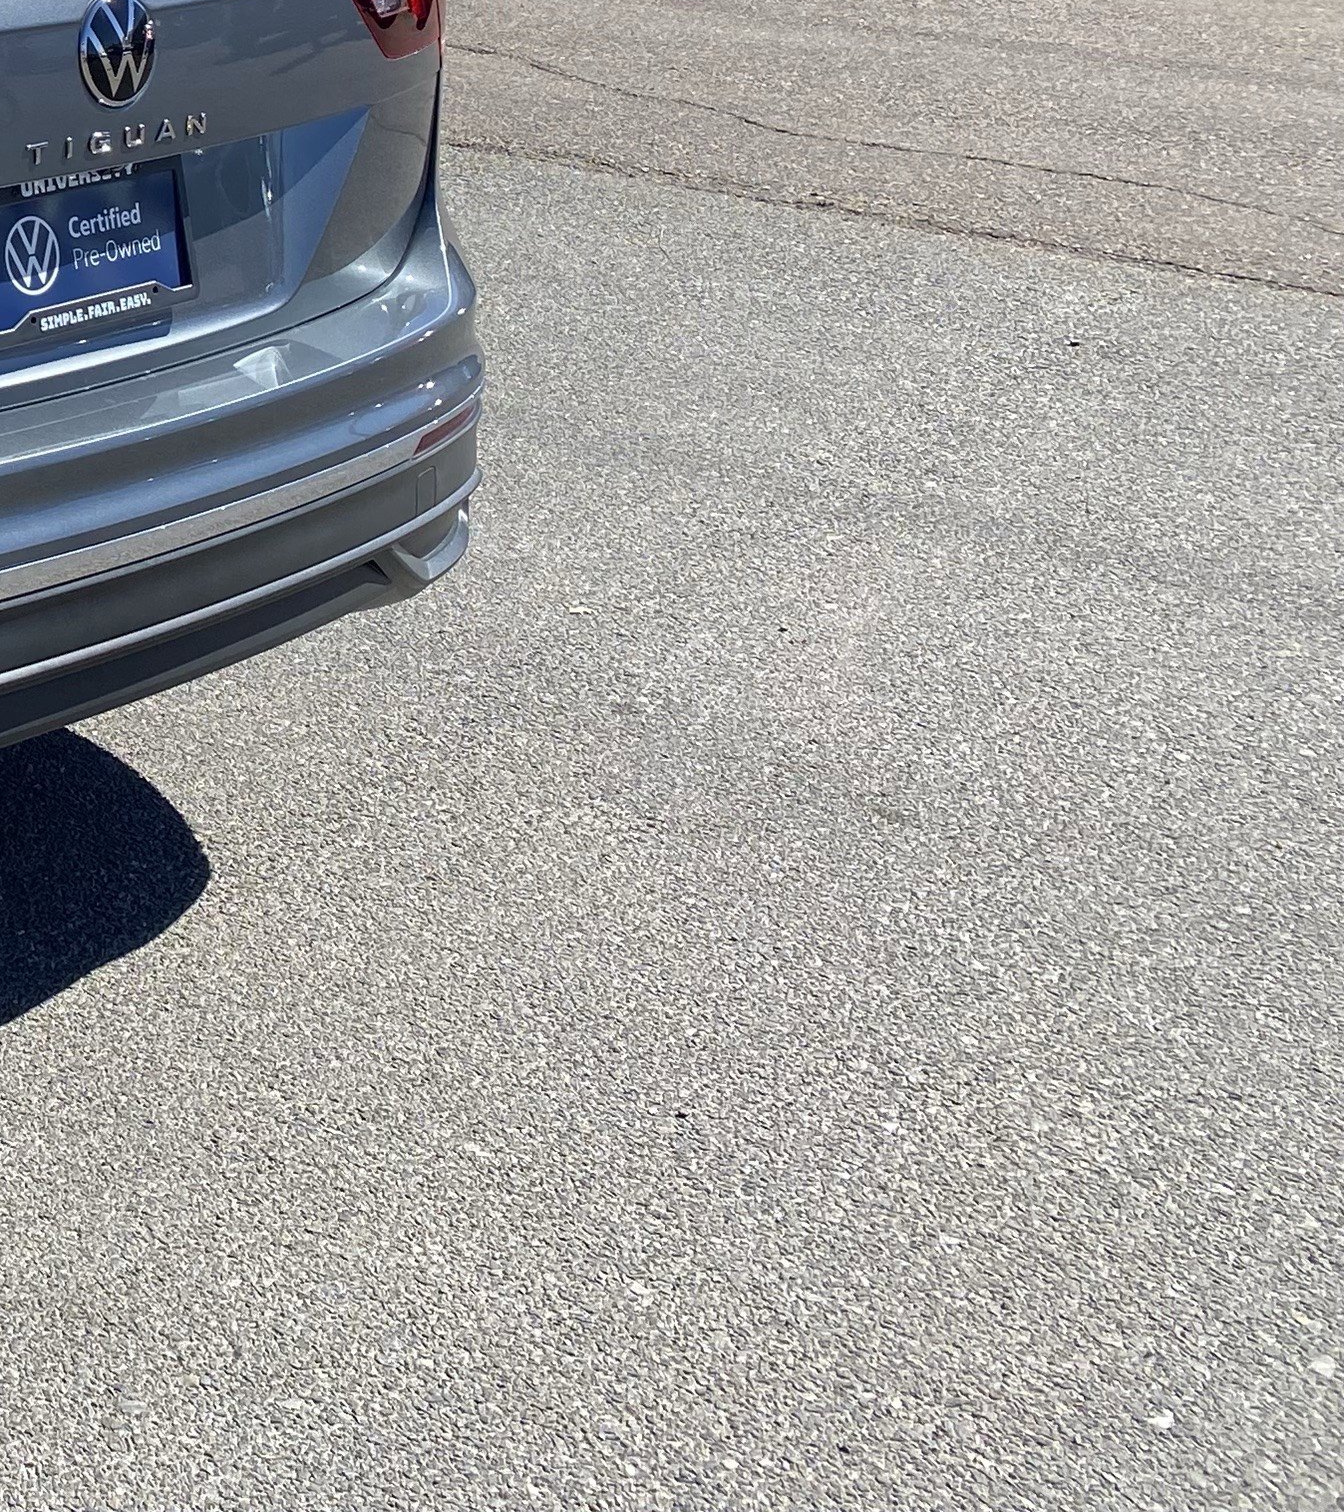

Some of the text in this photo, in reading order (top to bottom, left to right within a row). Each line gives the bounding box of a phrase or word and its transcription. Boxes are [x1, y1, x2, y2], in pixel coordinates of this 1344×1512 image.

[26, 112, 208, 166] TIGUAN
[68, 202, 142, 238] Certified
[72, 229, 162, 270] Pre-Owned
